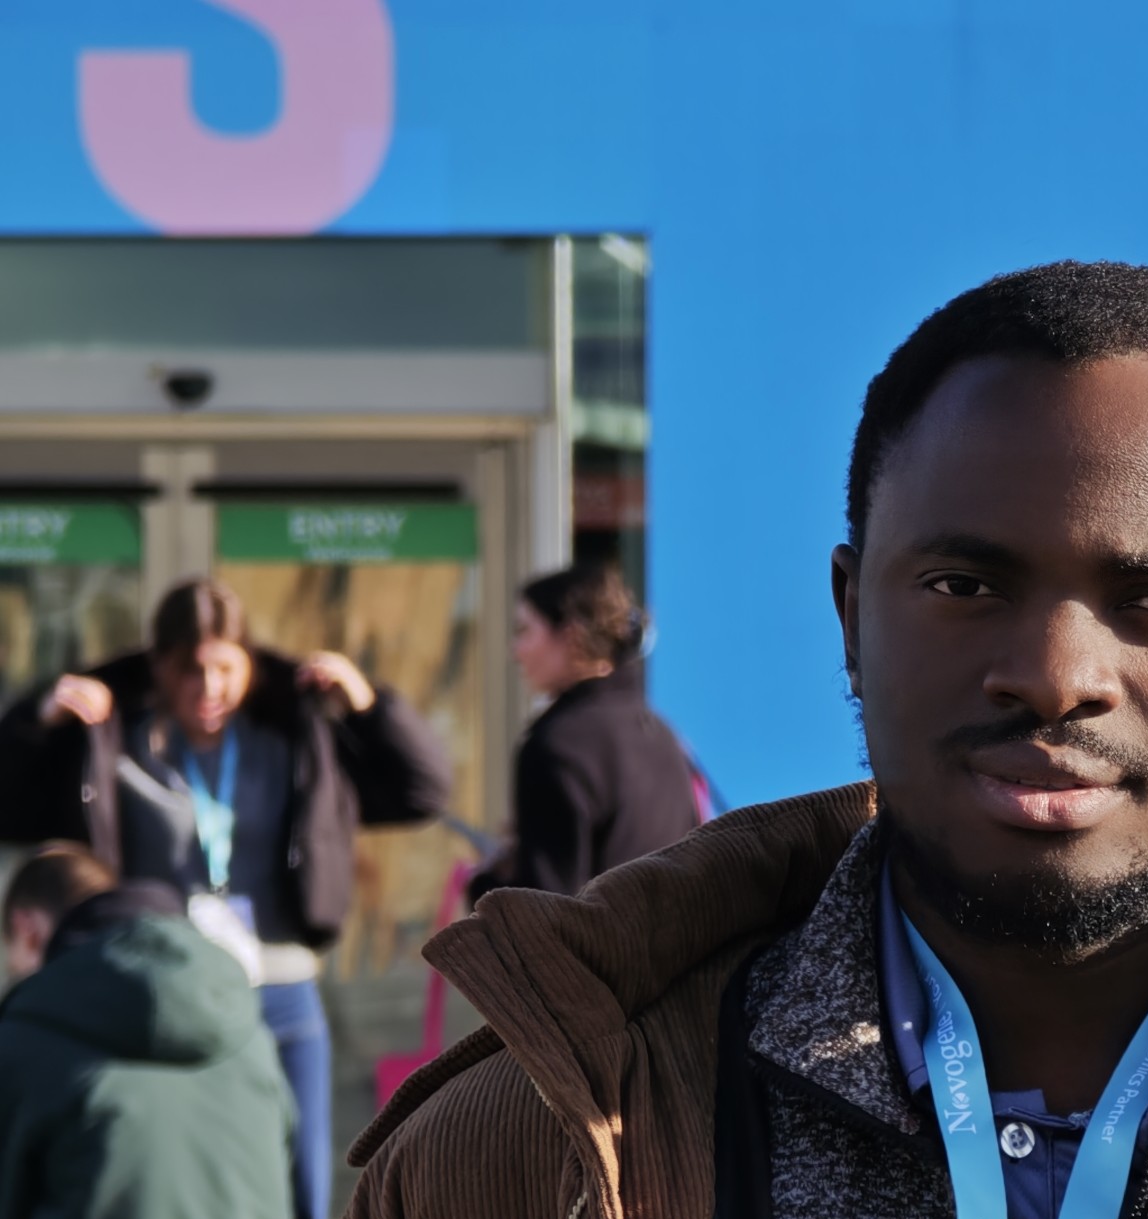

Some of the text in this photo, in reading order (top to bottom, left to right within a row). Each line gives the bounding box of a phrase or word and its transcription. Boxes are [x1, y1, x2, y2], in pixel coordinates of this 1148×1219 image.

[287, 509, 407, 543] ENTRY
[937, 1010, 977, 1135] Novogene
[1101, 1088, 1140, 1145] Partner
